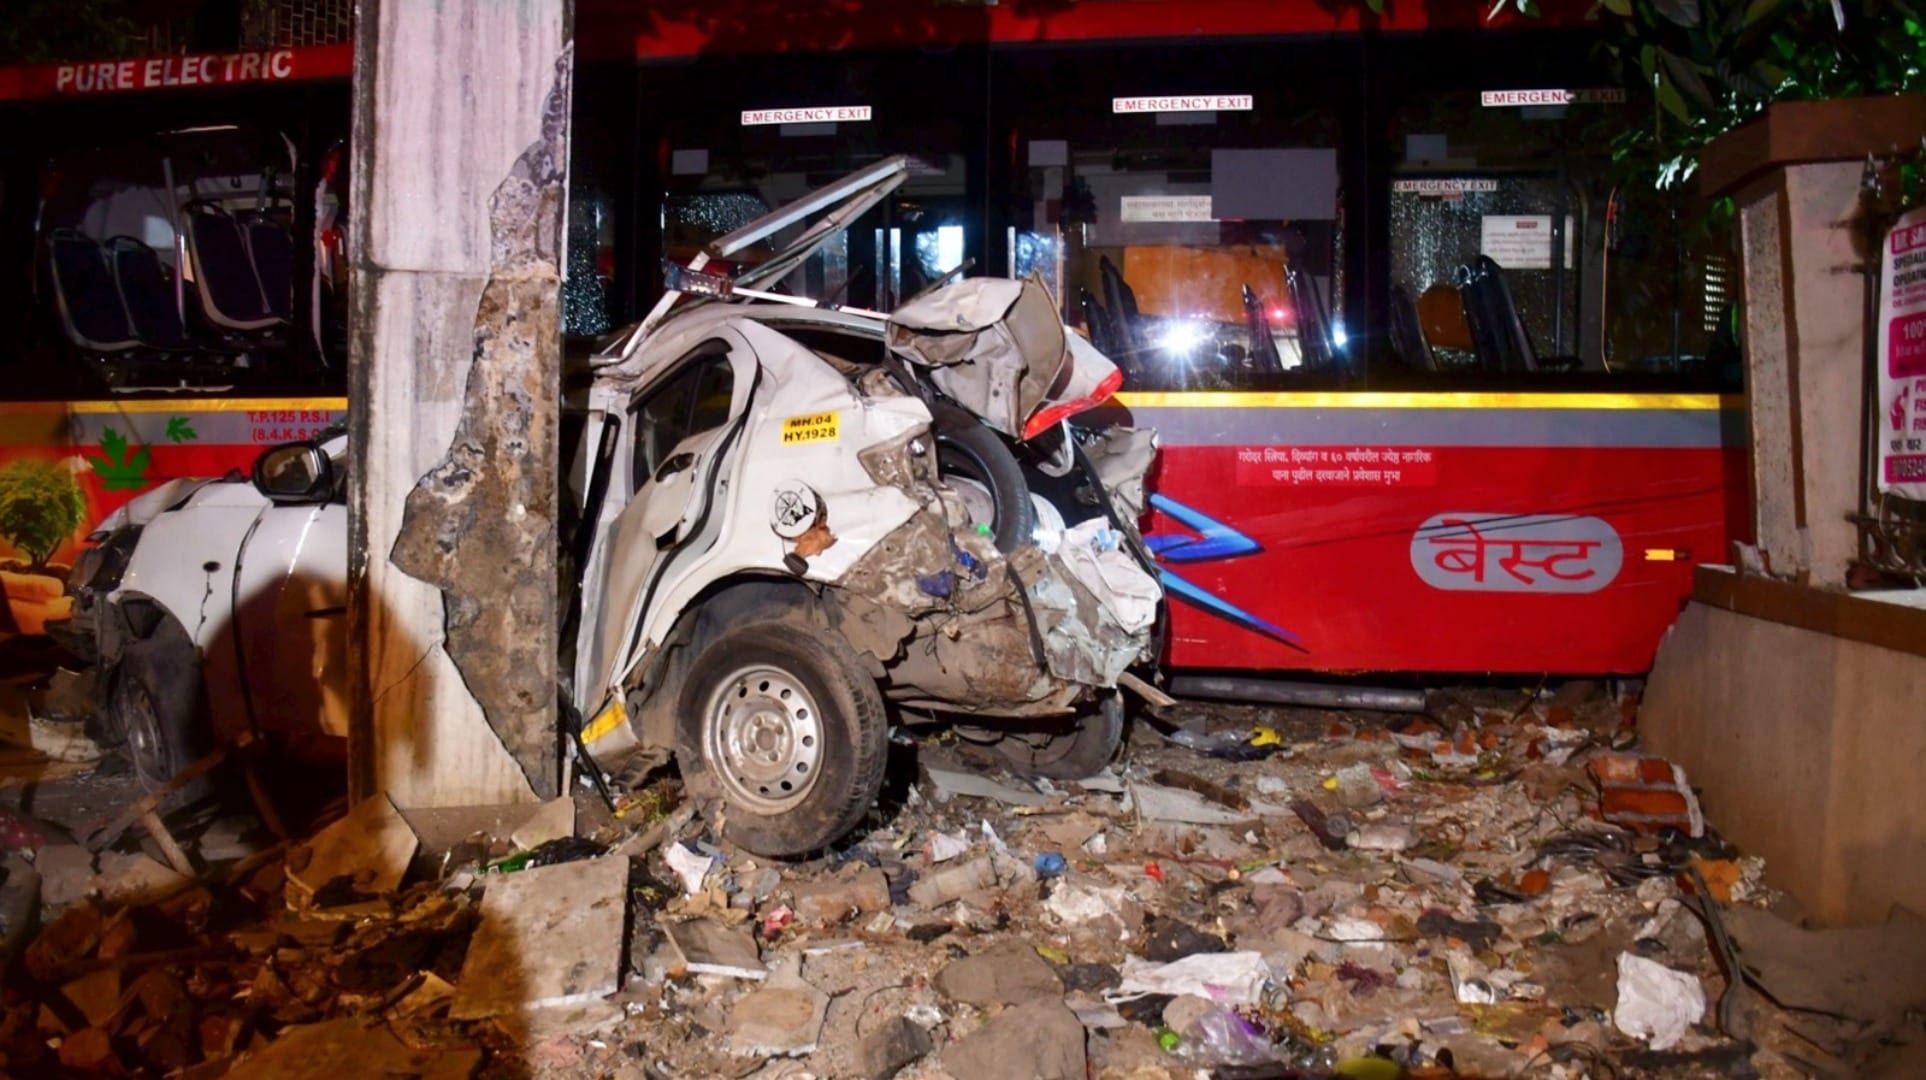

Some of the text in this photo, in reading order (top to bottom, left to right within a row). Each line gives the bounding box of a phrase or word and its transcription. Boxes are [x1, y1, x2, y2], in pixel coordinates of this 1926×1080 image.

[56, 51, 293, 92] PURE ELECTRIC
[1114, 96, 1250, 111] EMERGENCY EXIT
[742, 107, 870, 124] EMERGENCY EXIT
[1395, 180, 1496, 191] EMERGENCY EXIT
[247, 410, 295, 424] T.P.125
[784, 427, 836, 442] HY.1928
[1321, 451, 1328, 462] व
[1428, 518, 1602, 586] बेस्ट
